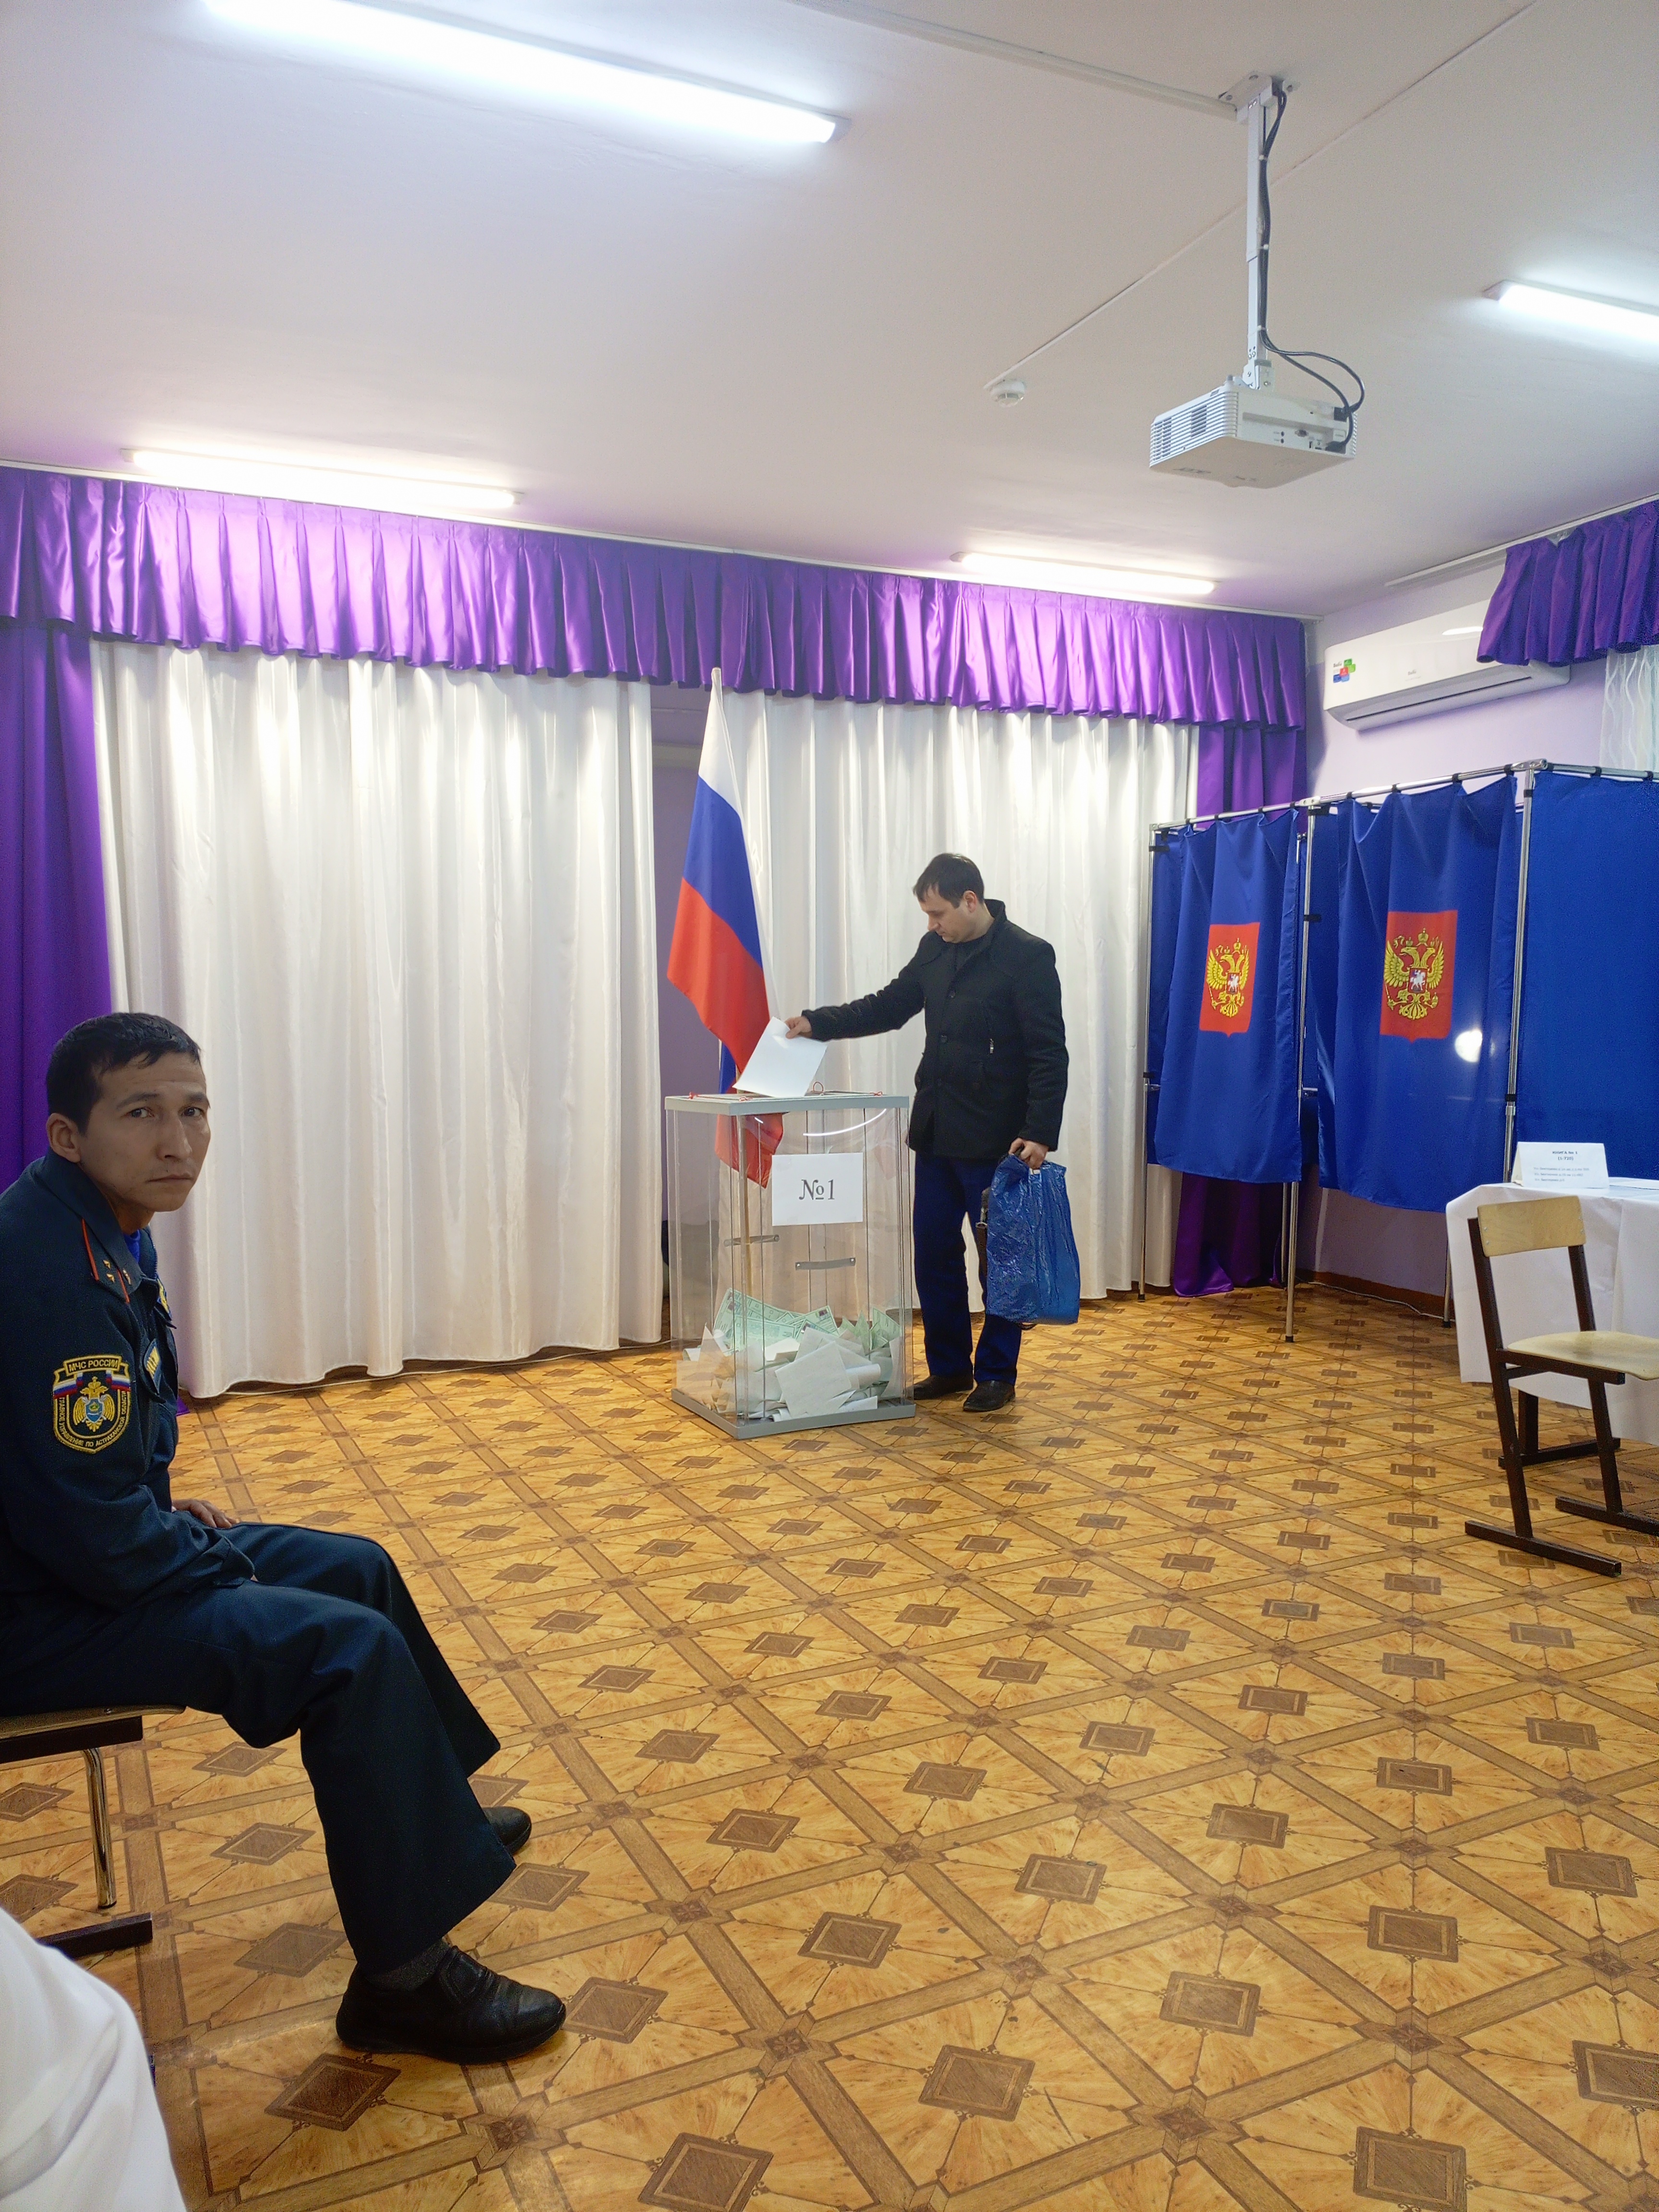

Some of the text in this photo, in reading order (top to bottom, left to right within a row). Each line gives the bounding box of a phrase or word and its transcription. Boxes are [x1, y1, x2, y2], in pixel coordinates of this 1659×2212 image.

[68, 1359, 118, 1372] МЧС РОССИИ
[59, 1422, 84, 1446] УПРАВЛЕНИЕ
[96, 1416, 125, 1447] АСТРАХАНСКОЙ
